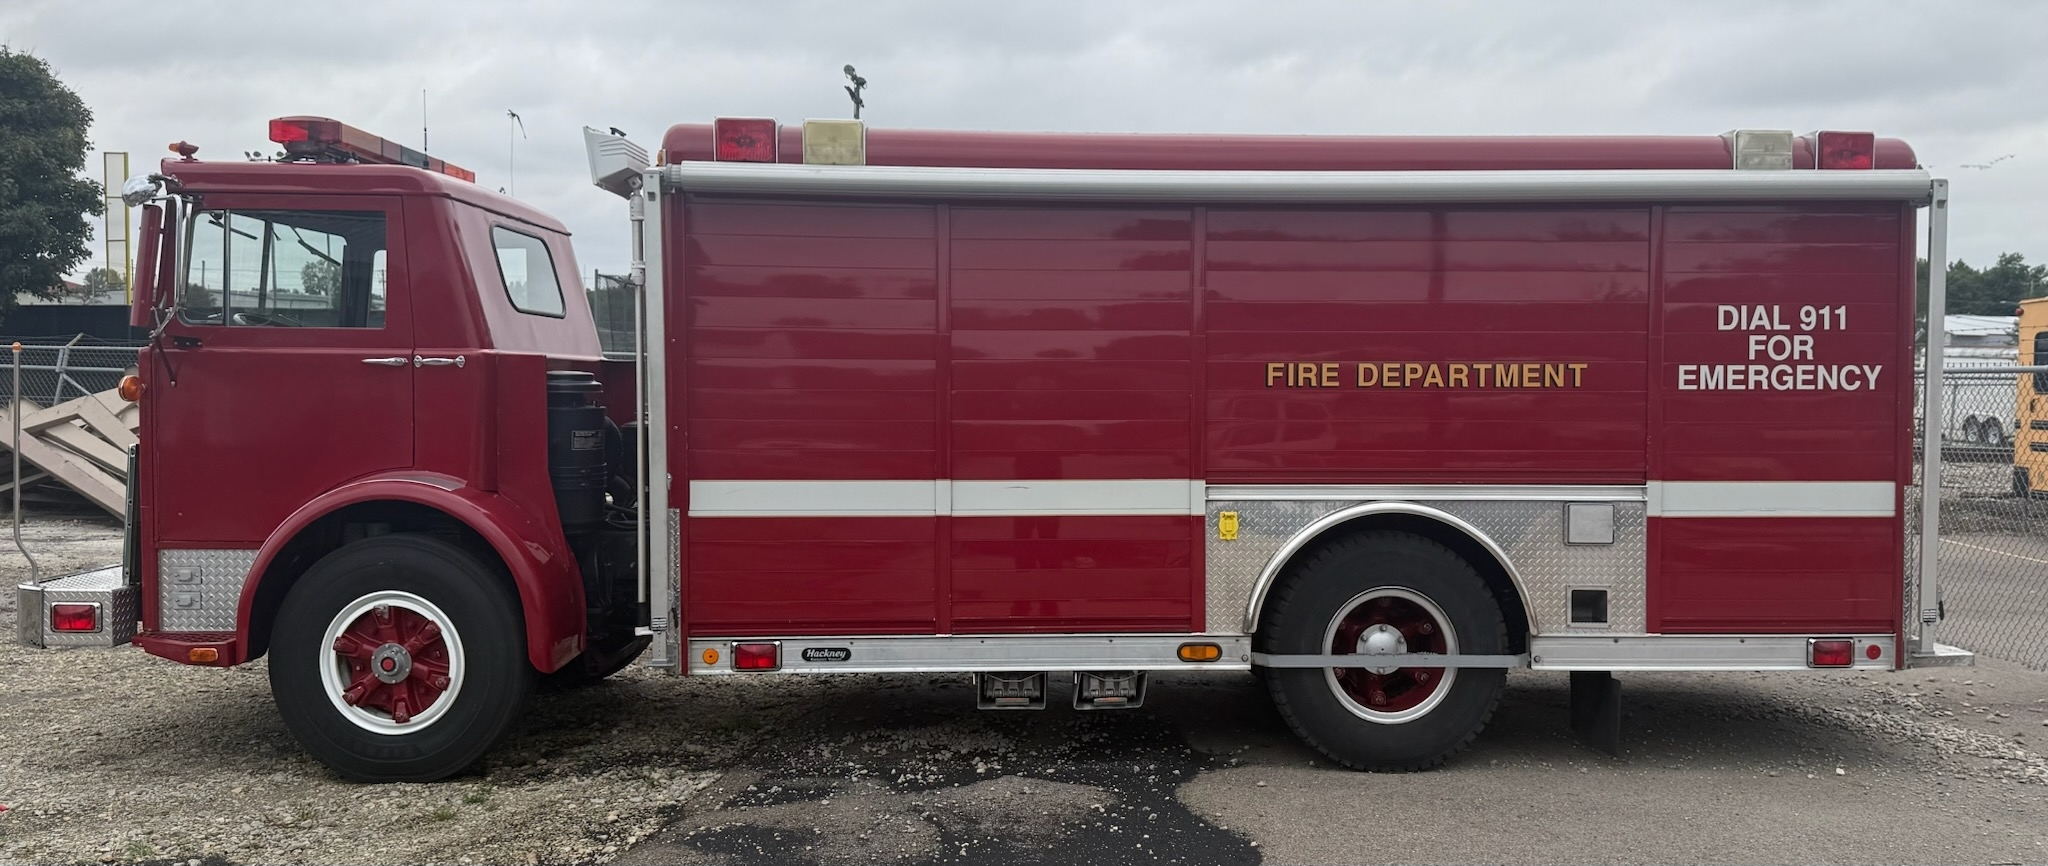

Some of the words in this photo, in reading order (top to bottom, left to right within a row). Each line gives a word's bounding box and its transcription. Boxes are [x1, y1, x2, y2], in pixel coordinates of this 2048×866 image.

[1717, 304, 1791, 331] DIAL
[1799, 305, 1846, 331] 911
[1748, 334, 1814, 361] FOR
[1267, 362, 1340, 388] FIRE
[1358, 362, 1588, 388] DEPARTMENT
[1678, 364, 1882, 391] EMERGENCY
[806, 649, 847, 660] Hackney
